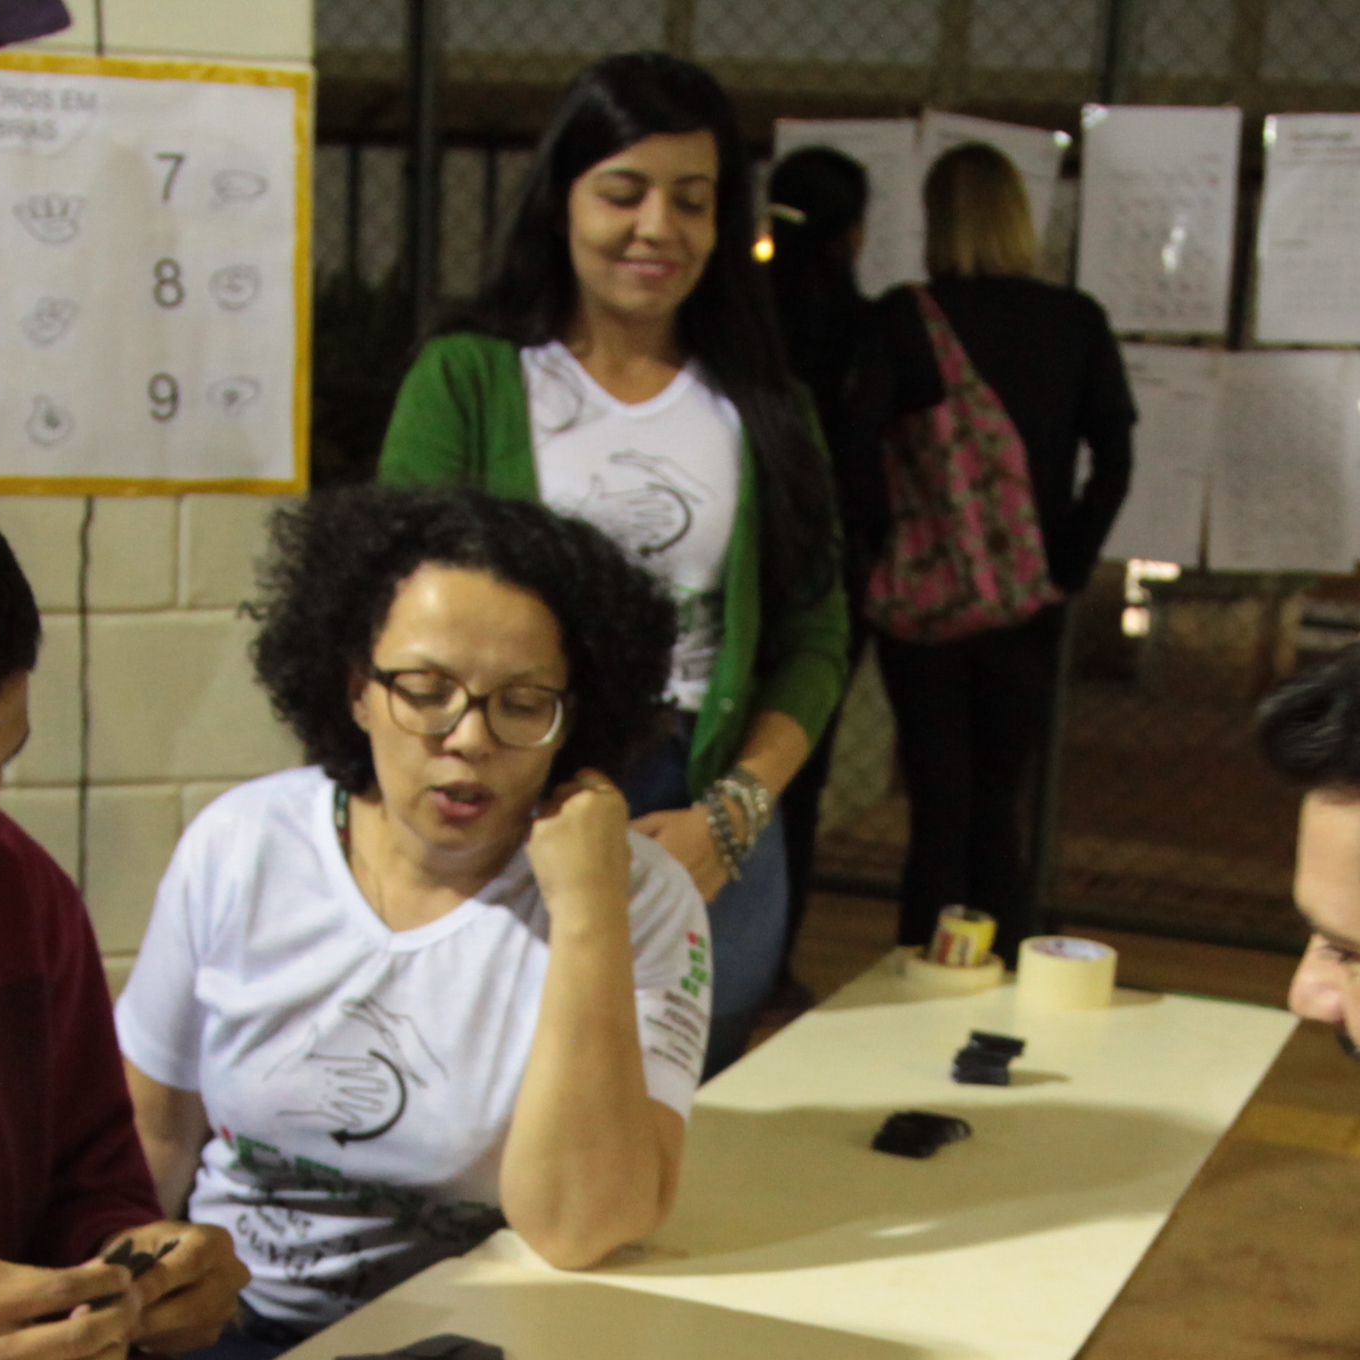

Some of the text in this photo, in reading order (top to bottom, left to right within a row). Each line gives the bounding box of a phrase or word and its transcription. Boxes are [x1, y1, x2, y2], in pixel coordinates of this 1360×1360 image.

[60, 88, 98, 111] EM
[155, 152, 185, 203] 7
[152, 256, 186, 310] 8
[147, 370, 180, 423] 9
